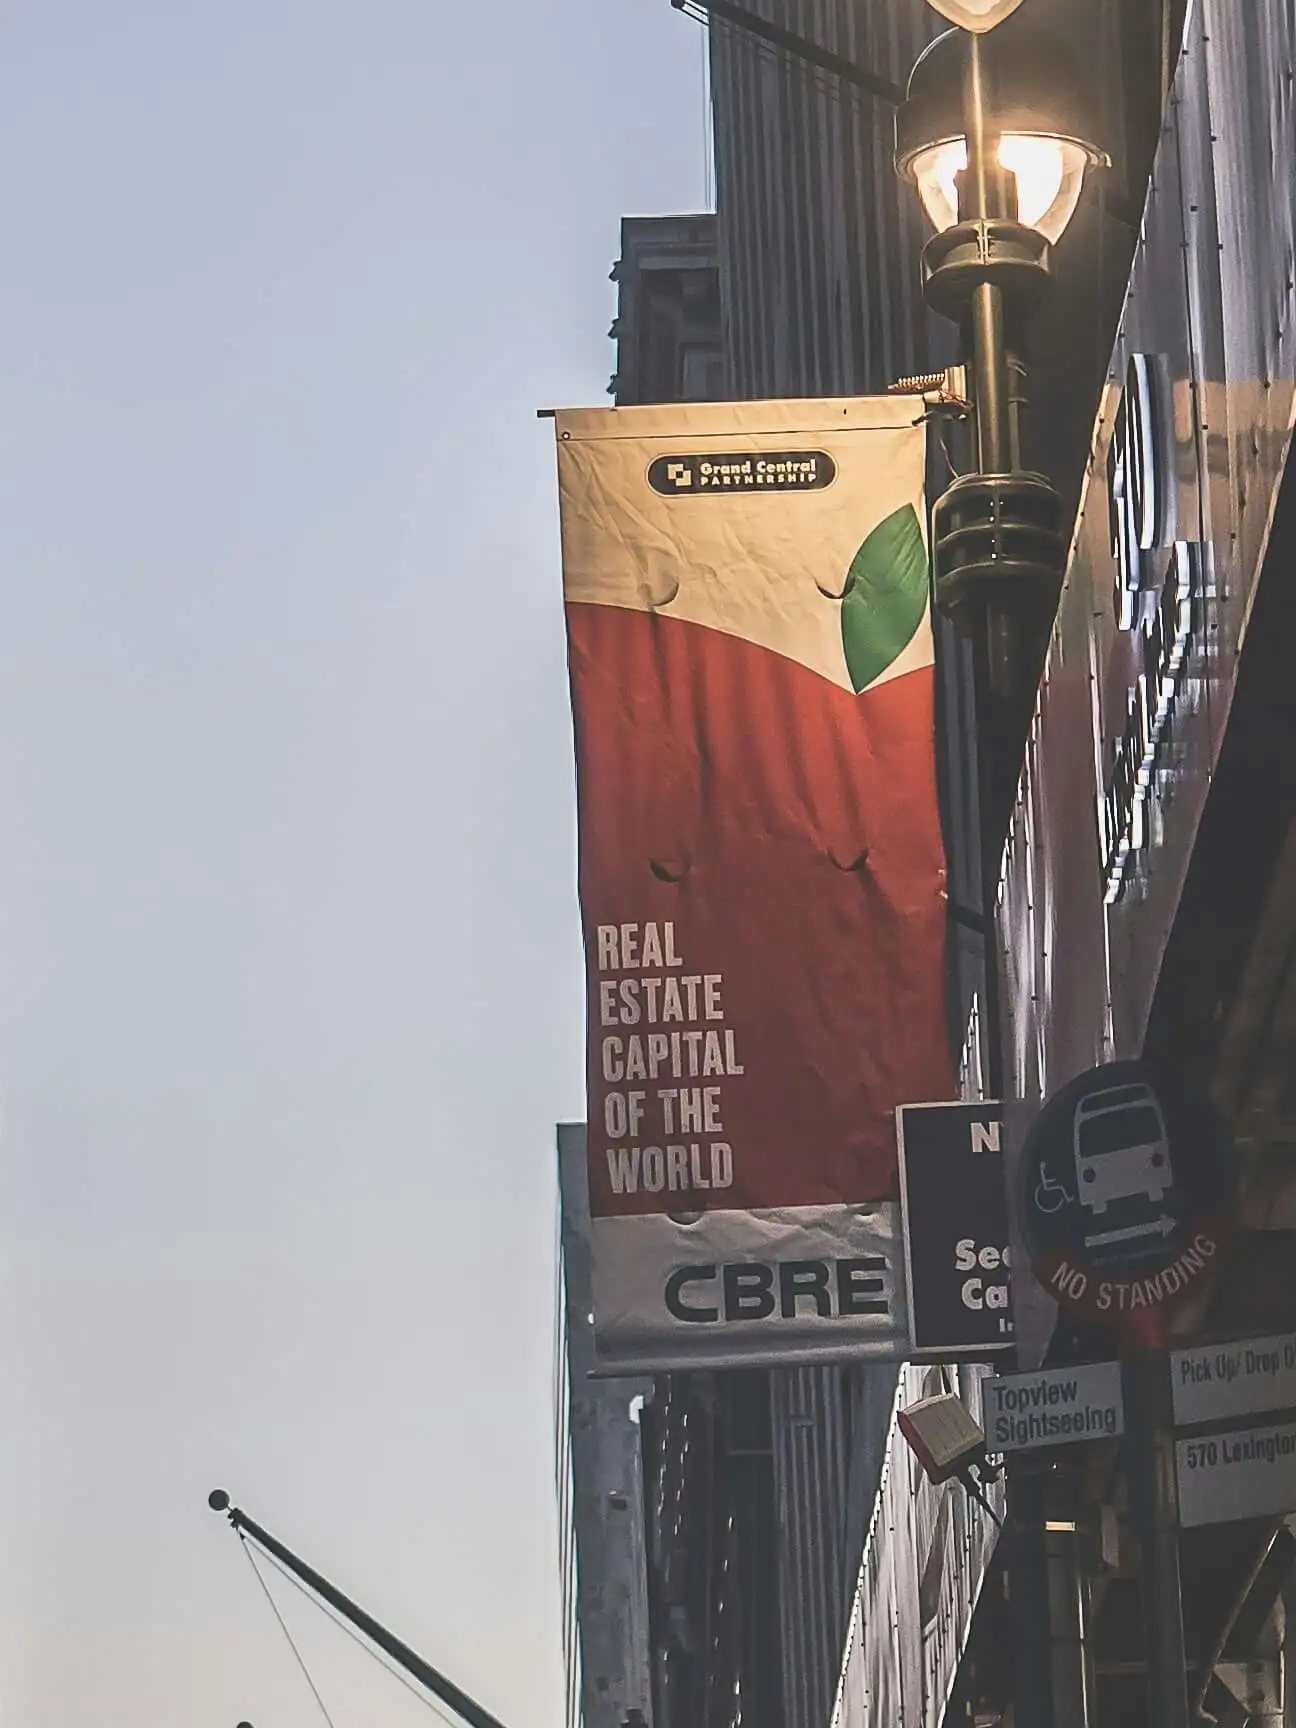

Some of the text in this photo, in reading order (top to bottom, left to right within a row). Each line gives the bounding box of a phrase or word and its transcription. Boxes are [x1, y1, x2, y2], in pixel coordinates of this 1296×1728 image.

[700, 459, 816, 475] Grand Central
[701, 474, 817, 486] PARTNERSHIP
[597, 921, 683, 970] REAL
[599, 974, 724, 1026] ESTATE
[602, 1029, 745, 1083] CAPITAL
[604, 1086, 723, 1139] OF THE
[606, 1142, 733, 1194] WORLD
[664, 1256, 889, 1324] CBRE
[1050, 1233, 1218, 1310] NO STANDING
[1181, 1359, 1212, 1386] Pick
[1246, 1348, 1280, 1378] Drop
[993, 1380, 1077, 1412] Topview
[995, 1406, 1116, 1445] Sightseeing
[1186, 1445, 1217, 1470] 570
